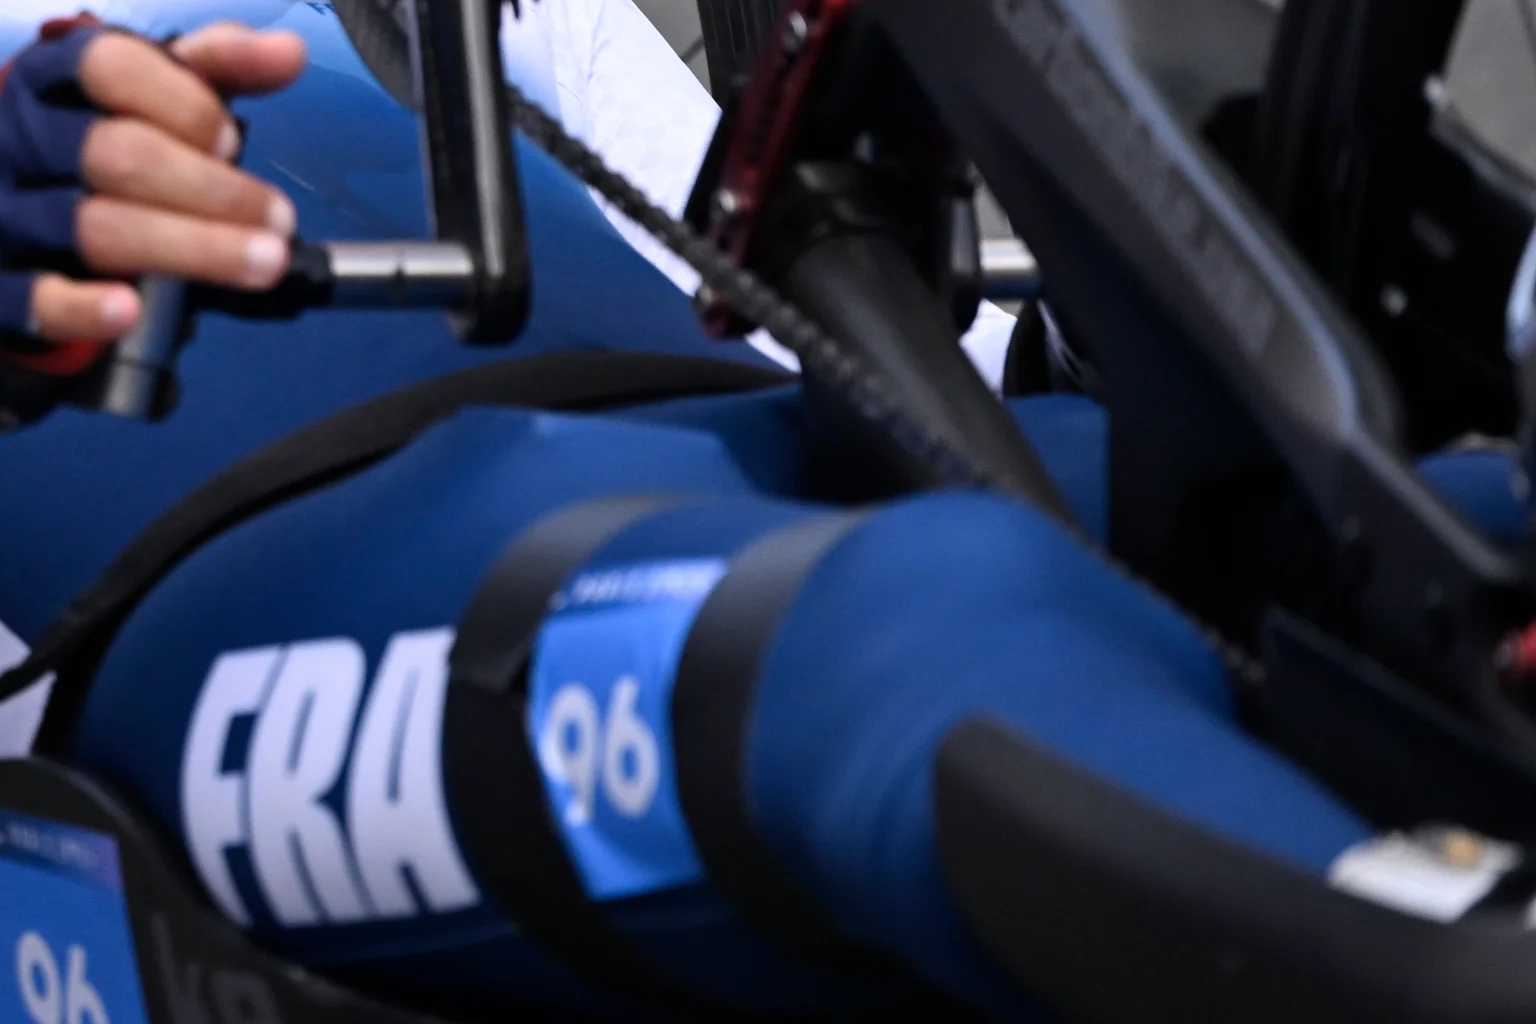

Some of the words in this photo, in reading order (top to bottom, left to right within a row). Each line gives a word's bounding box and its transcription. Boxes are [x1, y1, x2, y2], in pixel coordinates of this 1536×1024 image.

[180, 627, 480, 928] FRA
[541, 675, 660, 827] 96
[13, 929, 111, 1024] 96
